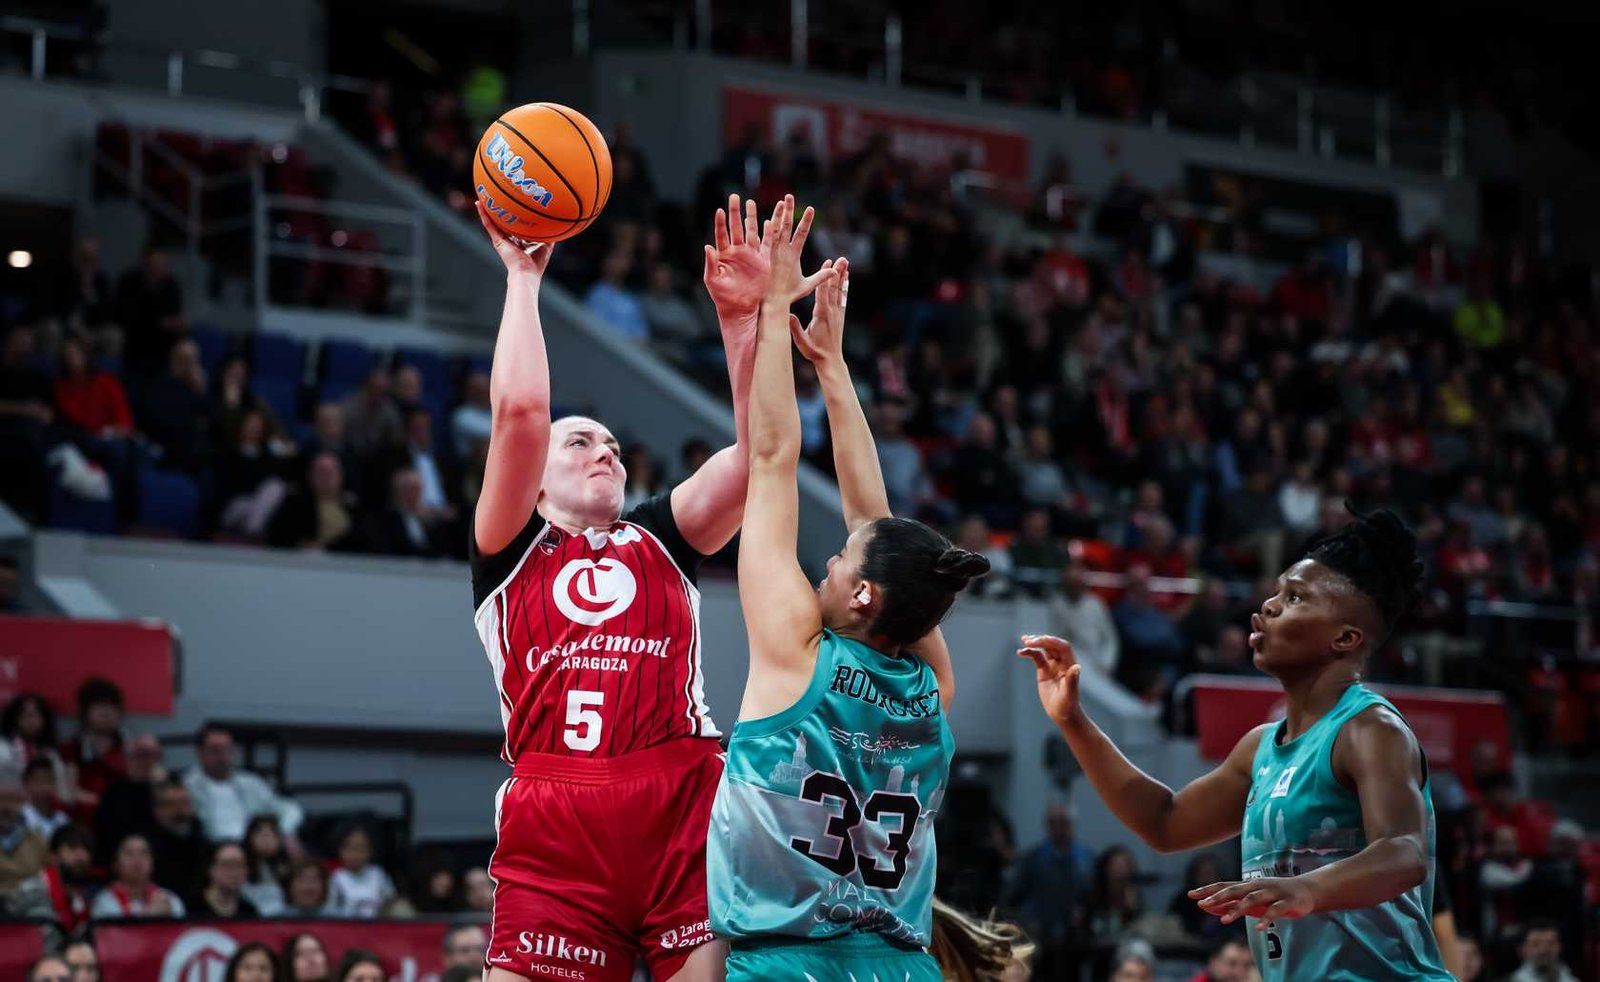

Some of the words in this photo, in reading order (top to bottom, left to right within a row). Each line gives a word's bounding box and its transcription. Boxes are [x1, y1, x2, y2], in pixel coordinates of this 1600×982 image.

[486, 132, 554, 208] Wilson
[557, 656, 629, 672] ARAGOZA
[828, 665, 940, 720] RODGUEZ
[563, 690, 605, 752] 5
[789, 771, 922, 891] 33
[516, 931, 607, 967] Silken
[531, 962, 585, 981] HOTELES
